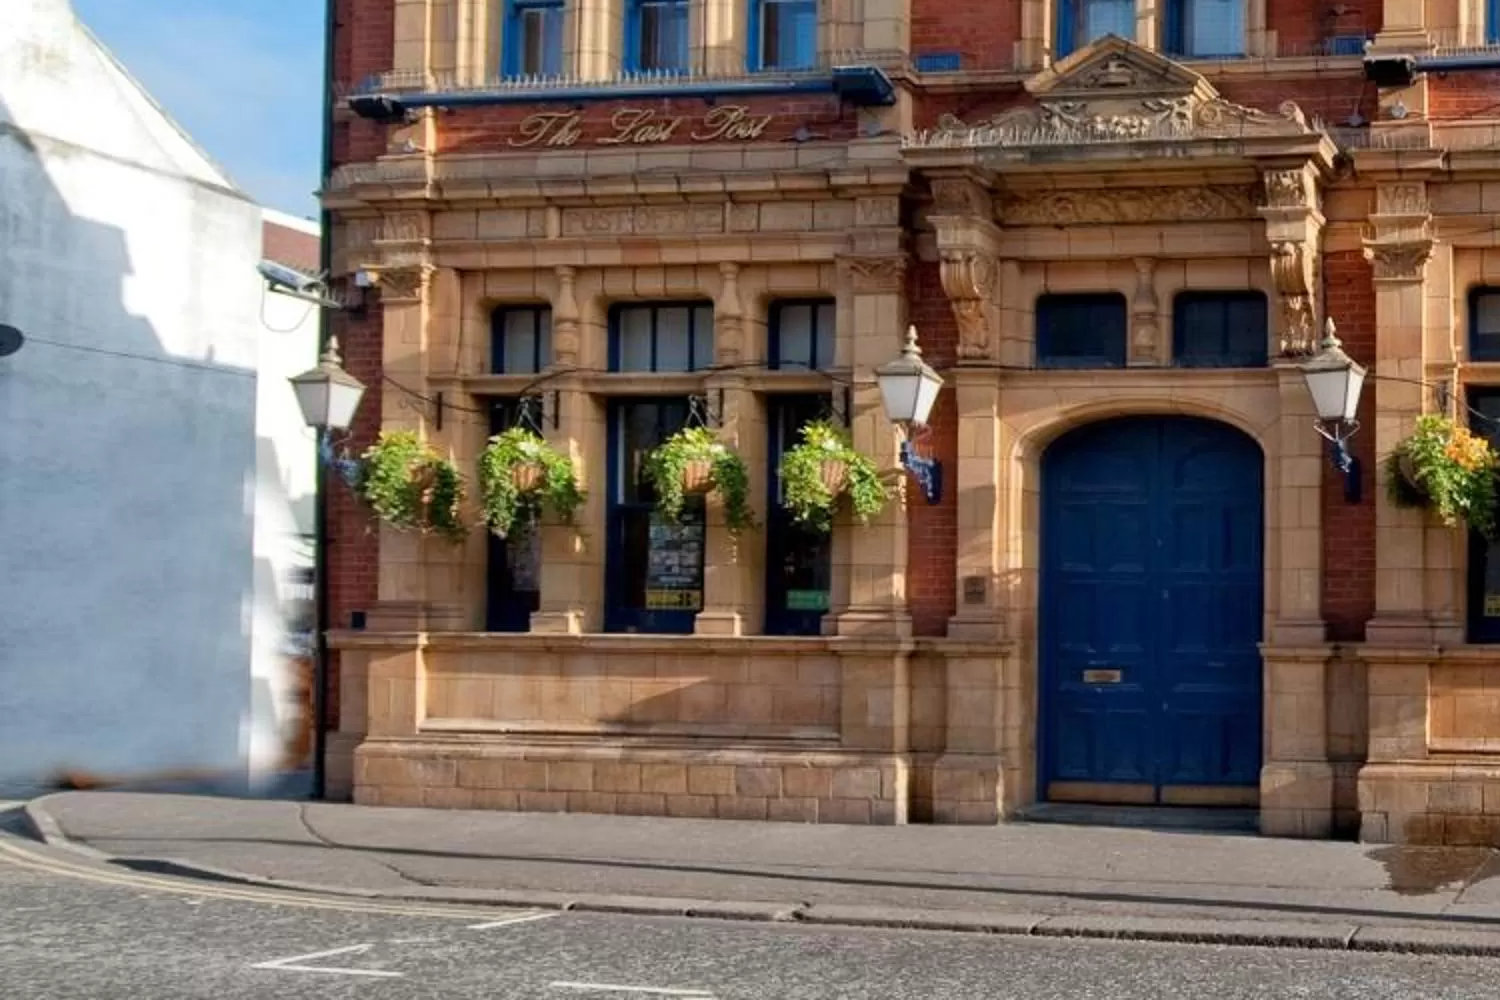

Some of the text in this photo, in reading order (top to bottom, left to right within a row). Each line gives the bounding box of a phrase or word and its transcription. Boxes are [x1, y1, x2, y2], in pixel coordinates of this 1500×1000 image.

[507, 105, 773, 147] The Last Post
